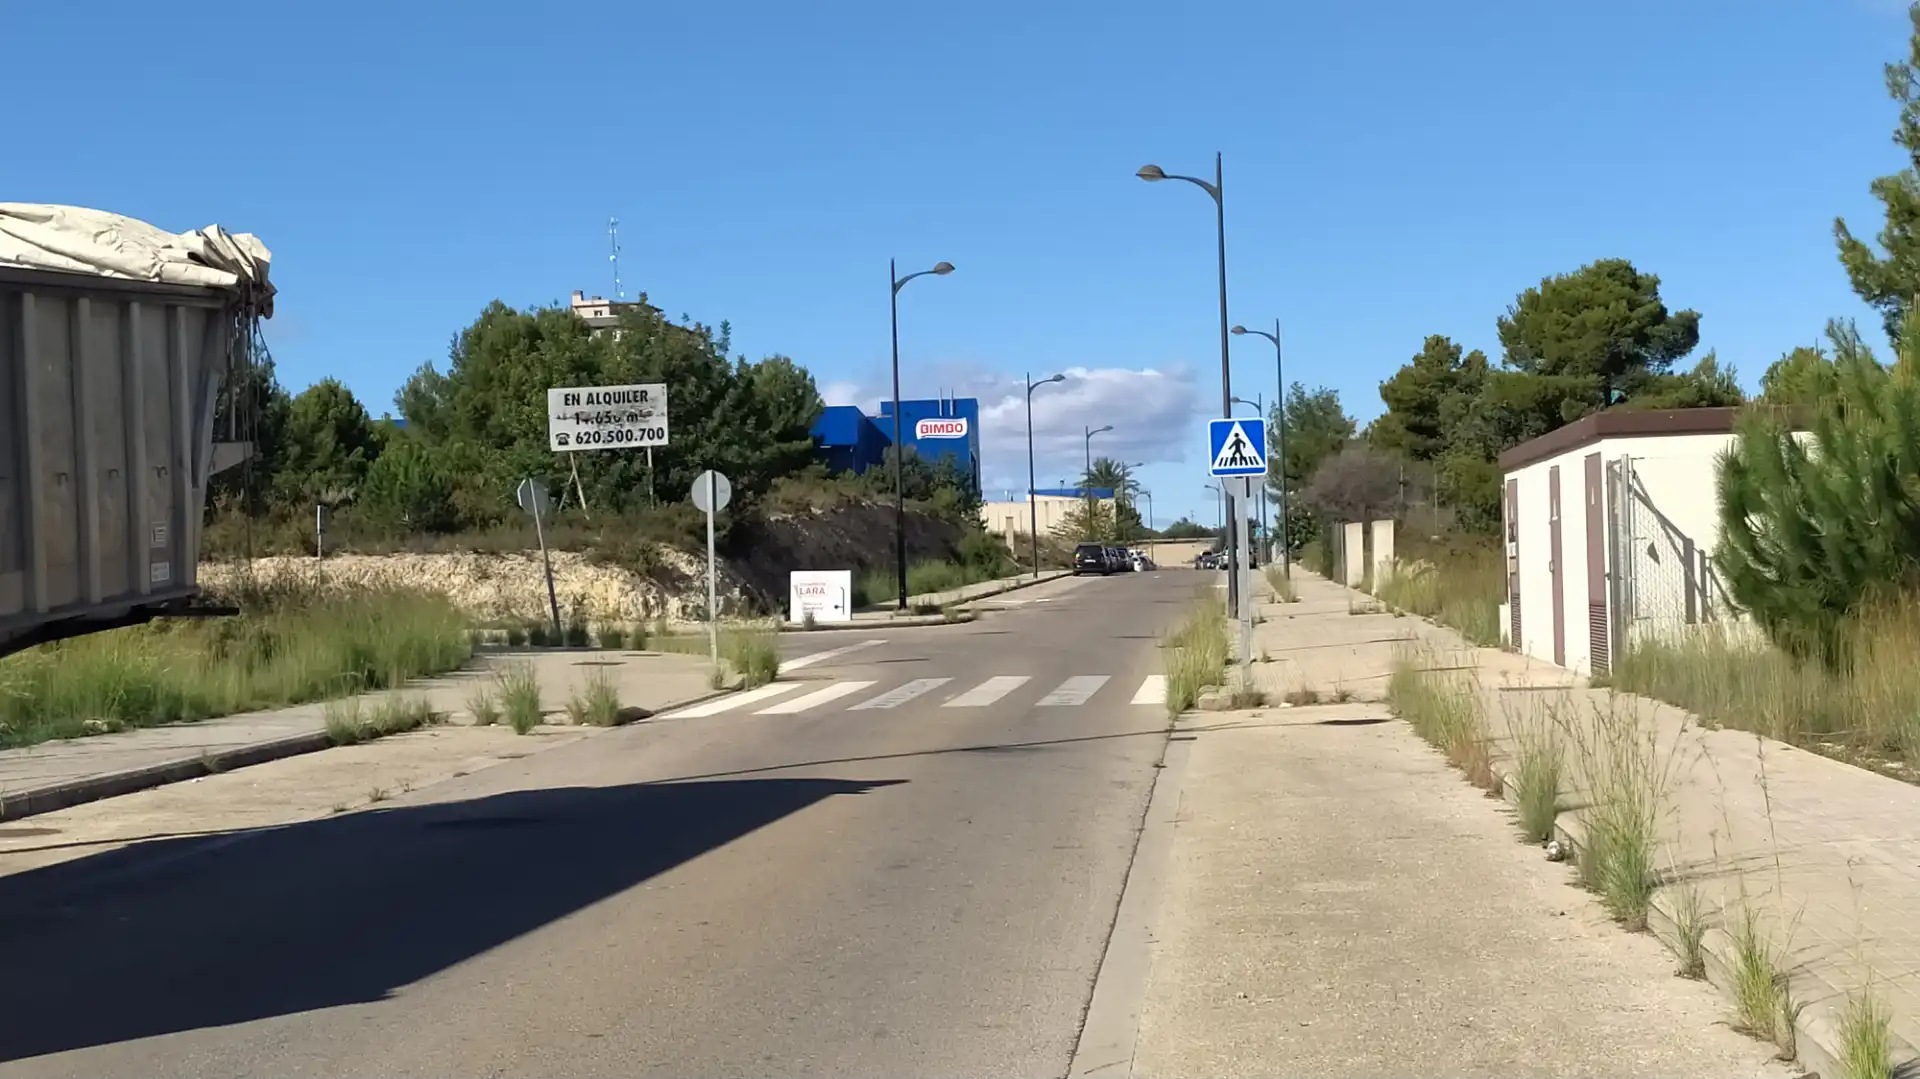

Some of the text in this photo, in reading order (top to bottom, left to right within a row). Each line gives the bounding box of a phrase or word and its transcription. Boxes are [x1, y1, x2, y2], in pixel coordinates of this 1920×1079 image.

[564, 390, 648, 406] EN ALQUILER
[920, 423, 963, 434] BIMBO
[575, 427, 665, 445] 620.500.700
[799, 587, 826, 595] LARA
